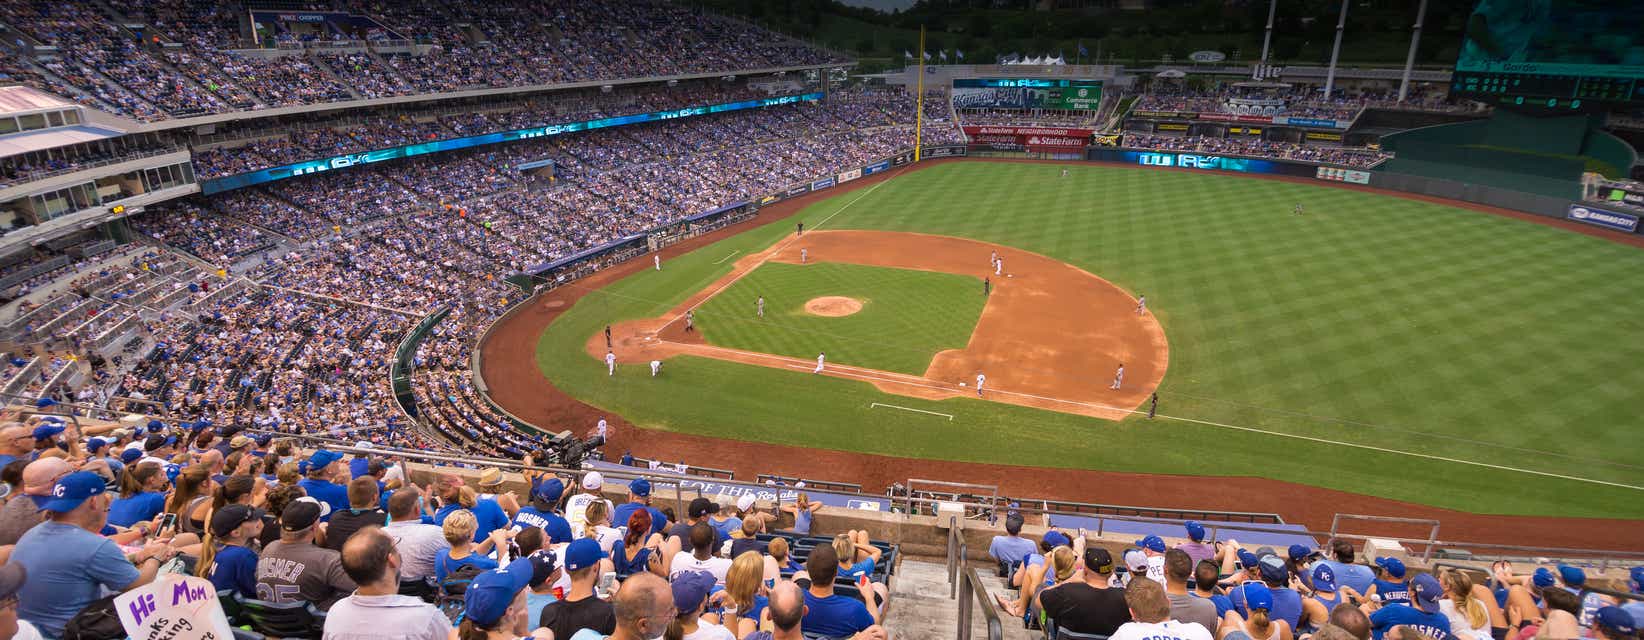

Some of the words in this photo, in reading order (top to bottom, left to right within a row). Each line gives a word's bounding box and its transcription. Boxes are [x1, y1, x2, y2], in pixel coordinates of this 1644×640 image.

[1252, 64, 1282, 81] Lite
[53, 484, 66, 497] KC
[1321, 571, 1331, 581] KC
[129, 593, 156, 627] Hi
[147, 617, 169, 640] nks
[1406, 624, 1447, 640] OSMER
